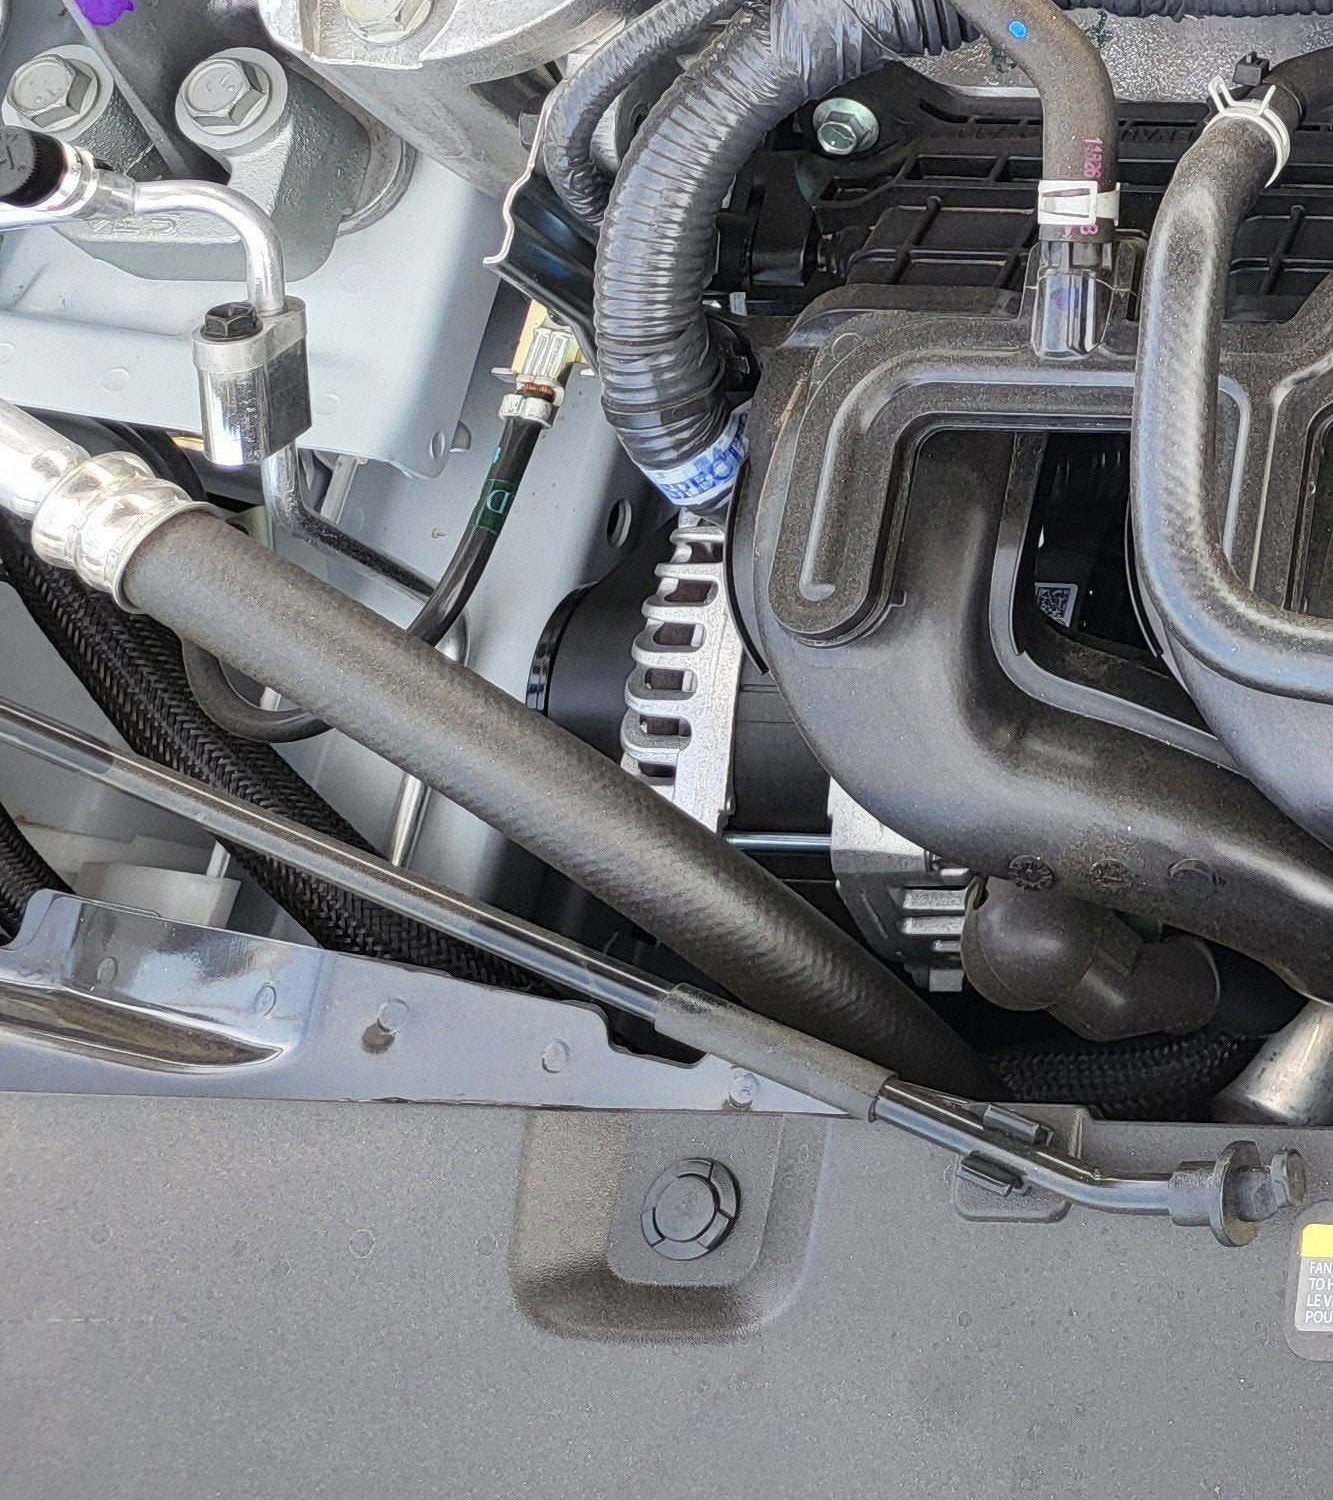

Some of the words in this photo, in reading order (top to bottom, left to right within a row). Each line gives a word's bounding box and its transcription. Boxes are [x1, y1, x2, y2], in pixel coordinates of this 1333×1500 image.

[1309, 1261, 1333, 1275] FAN
[1309, 1278, 1328, 1290] TO
[1307, 1294, 1323, 1307] LE
